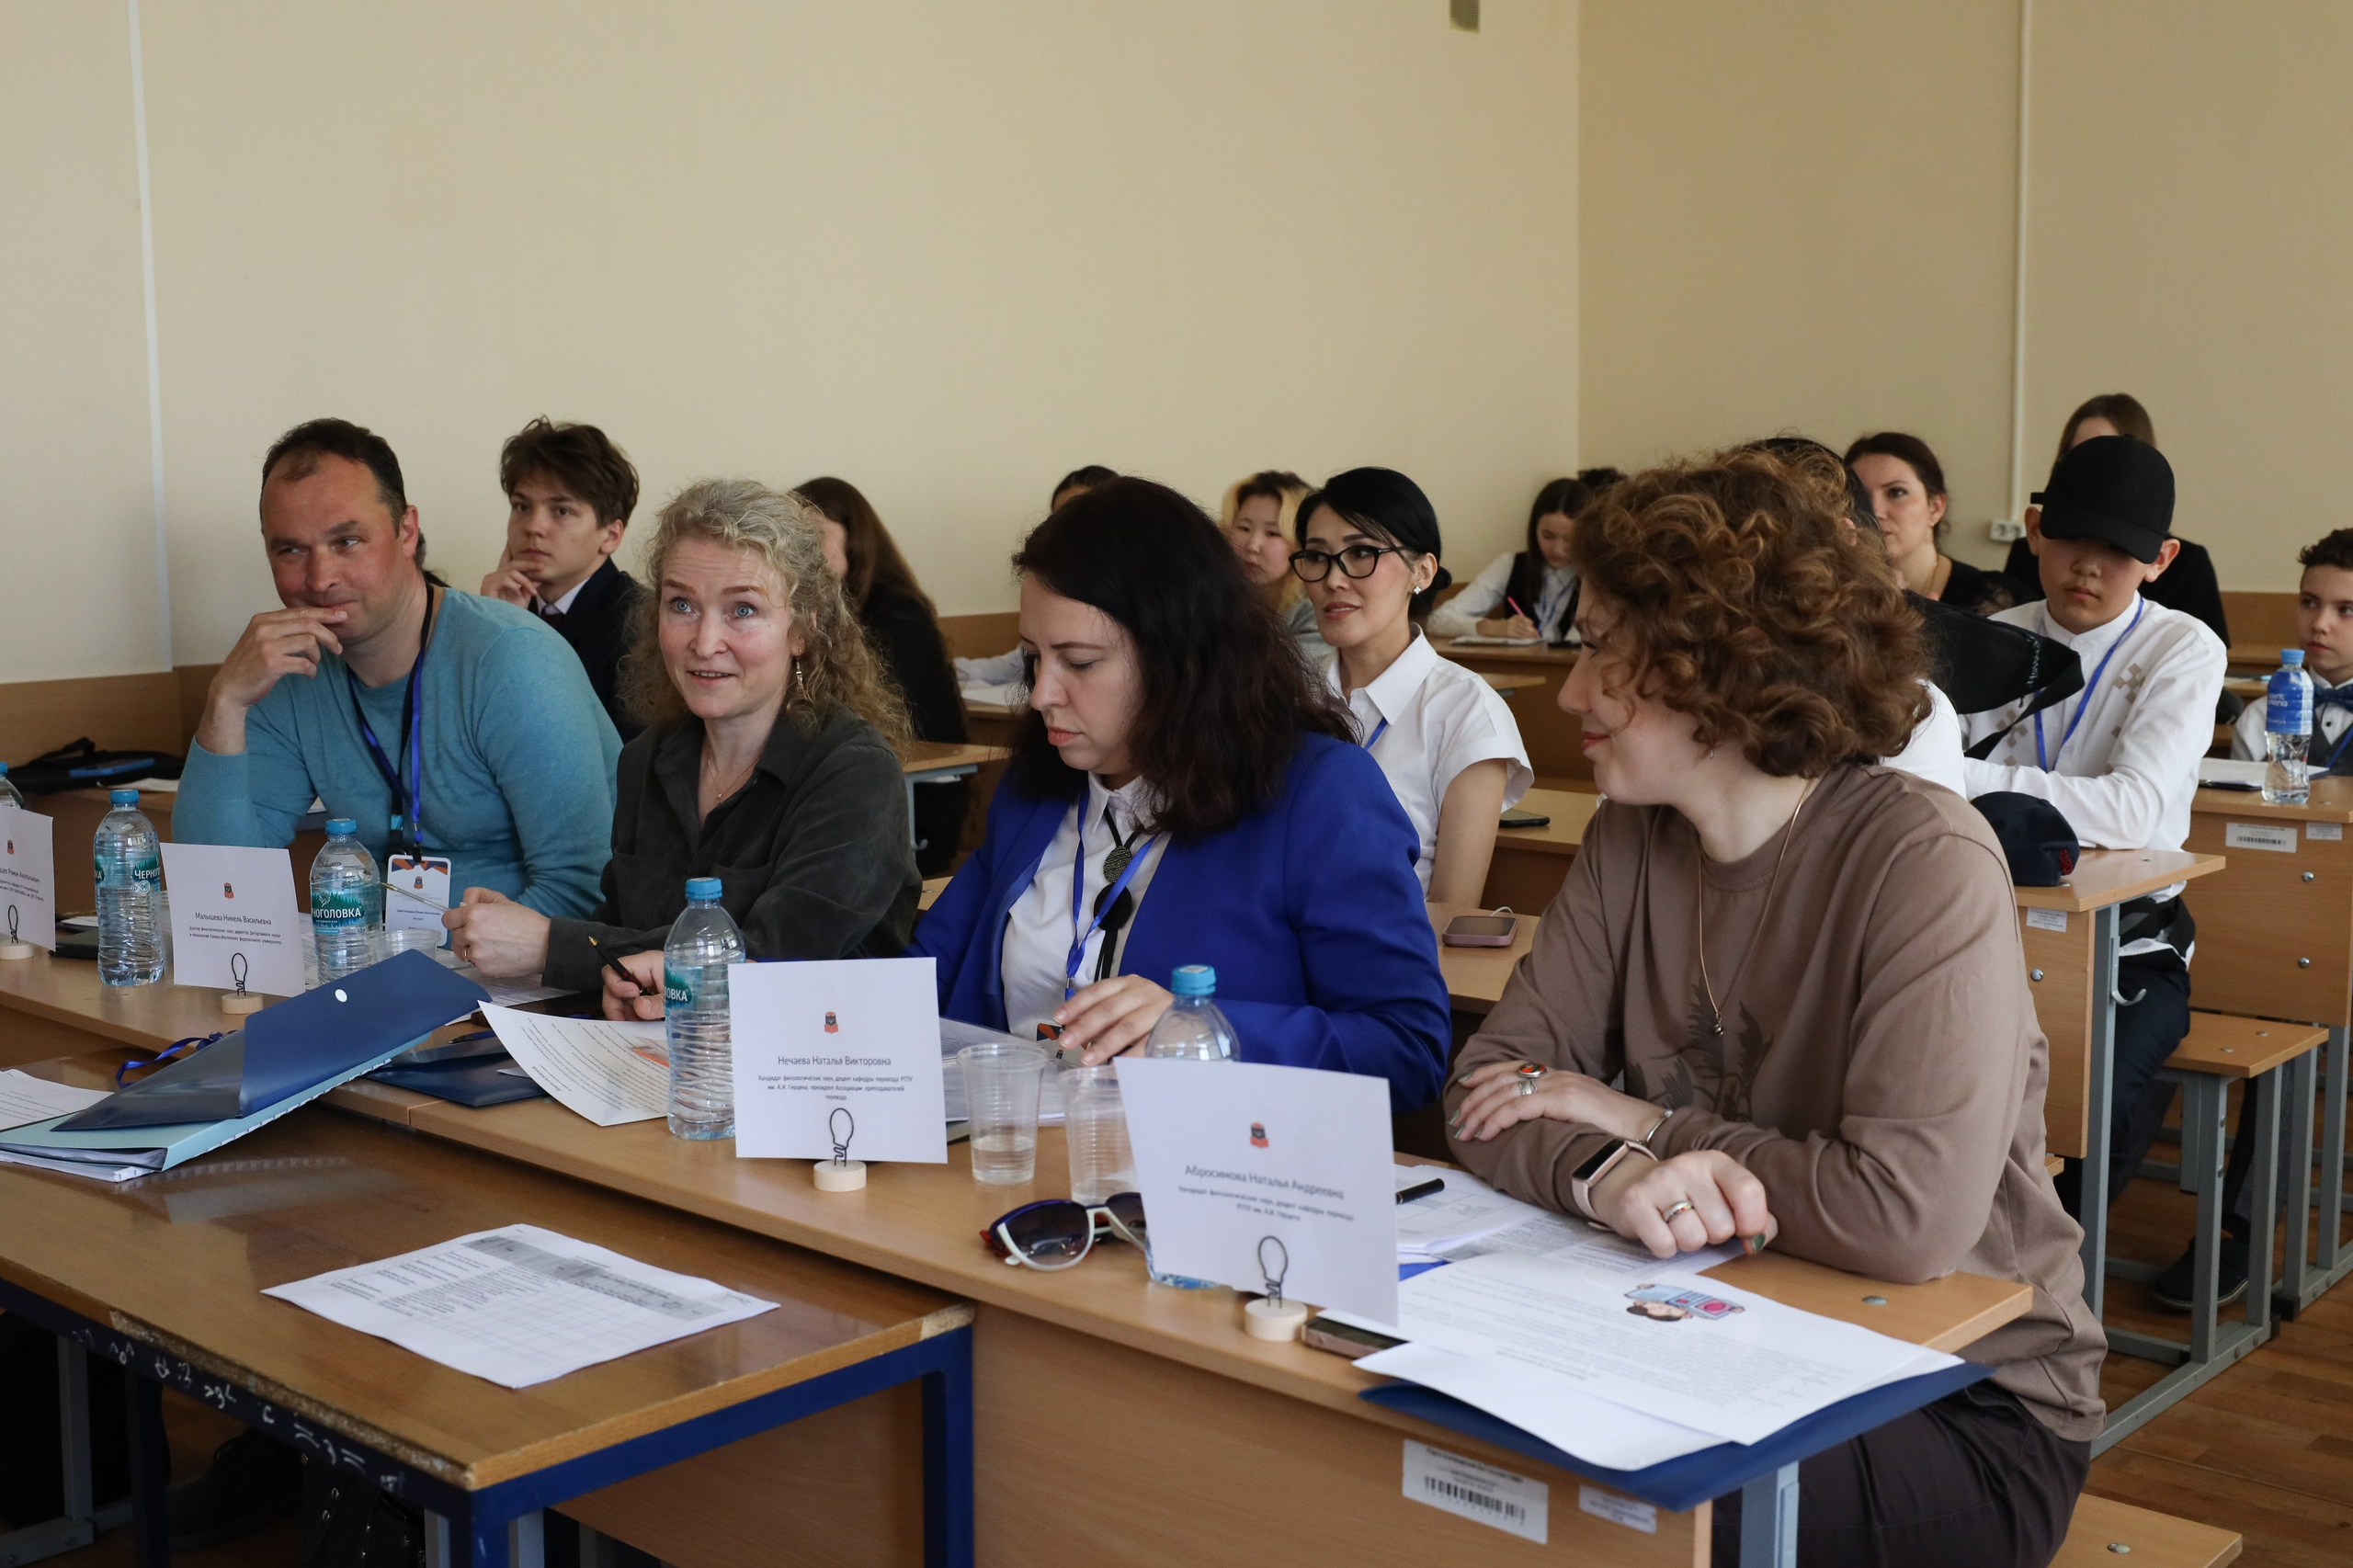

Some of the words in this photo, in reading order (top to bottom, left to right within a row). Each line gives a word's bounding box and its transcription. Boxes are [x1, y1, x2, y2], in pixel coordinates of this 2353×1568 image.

[195, 913, 222, 921] Малышева
[223, 915, 243, 923] Нинель
[243, 915, 272, 926] Васильевна
[778, 1056, 811, 1066] Нечаева
[812, 1056, 844, 1066] Наталья
[845, 1056, 892, 1067] Викторовна
[1185, 1165, 1247, 1183] Абросимова
[1248, 1173, 1290, 1188] Наталья
[1291, 1179, 1345, 1200] Андреевна
